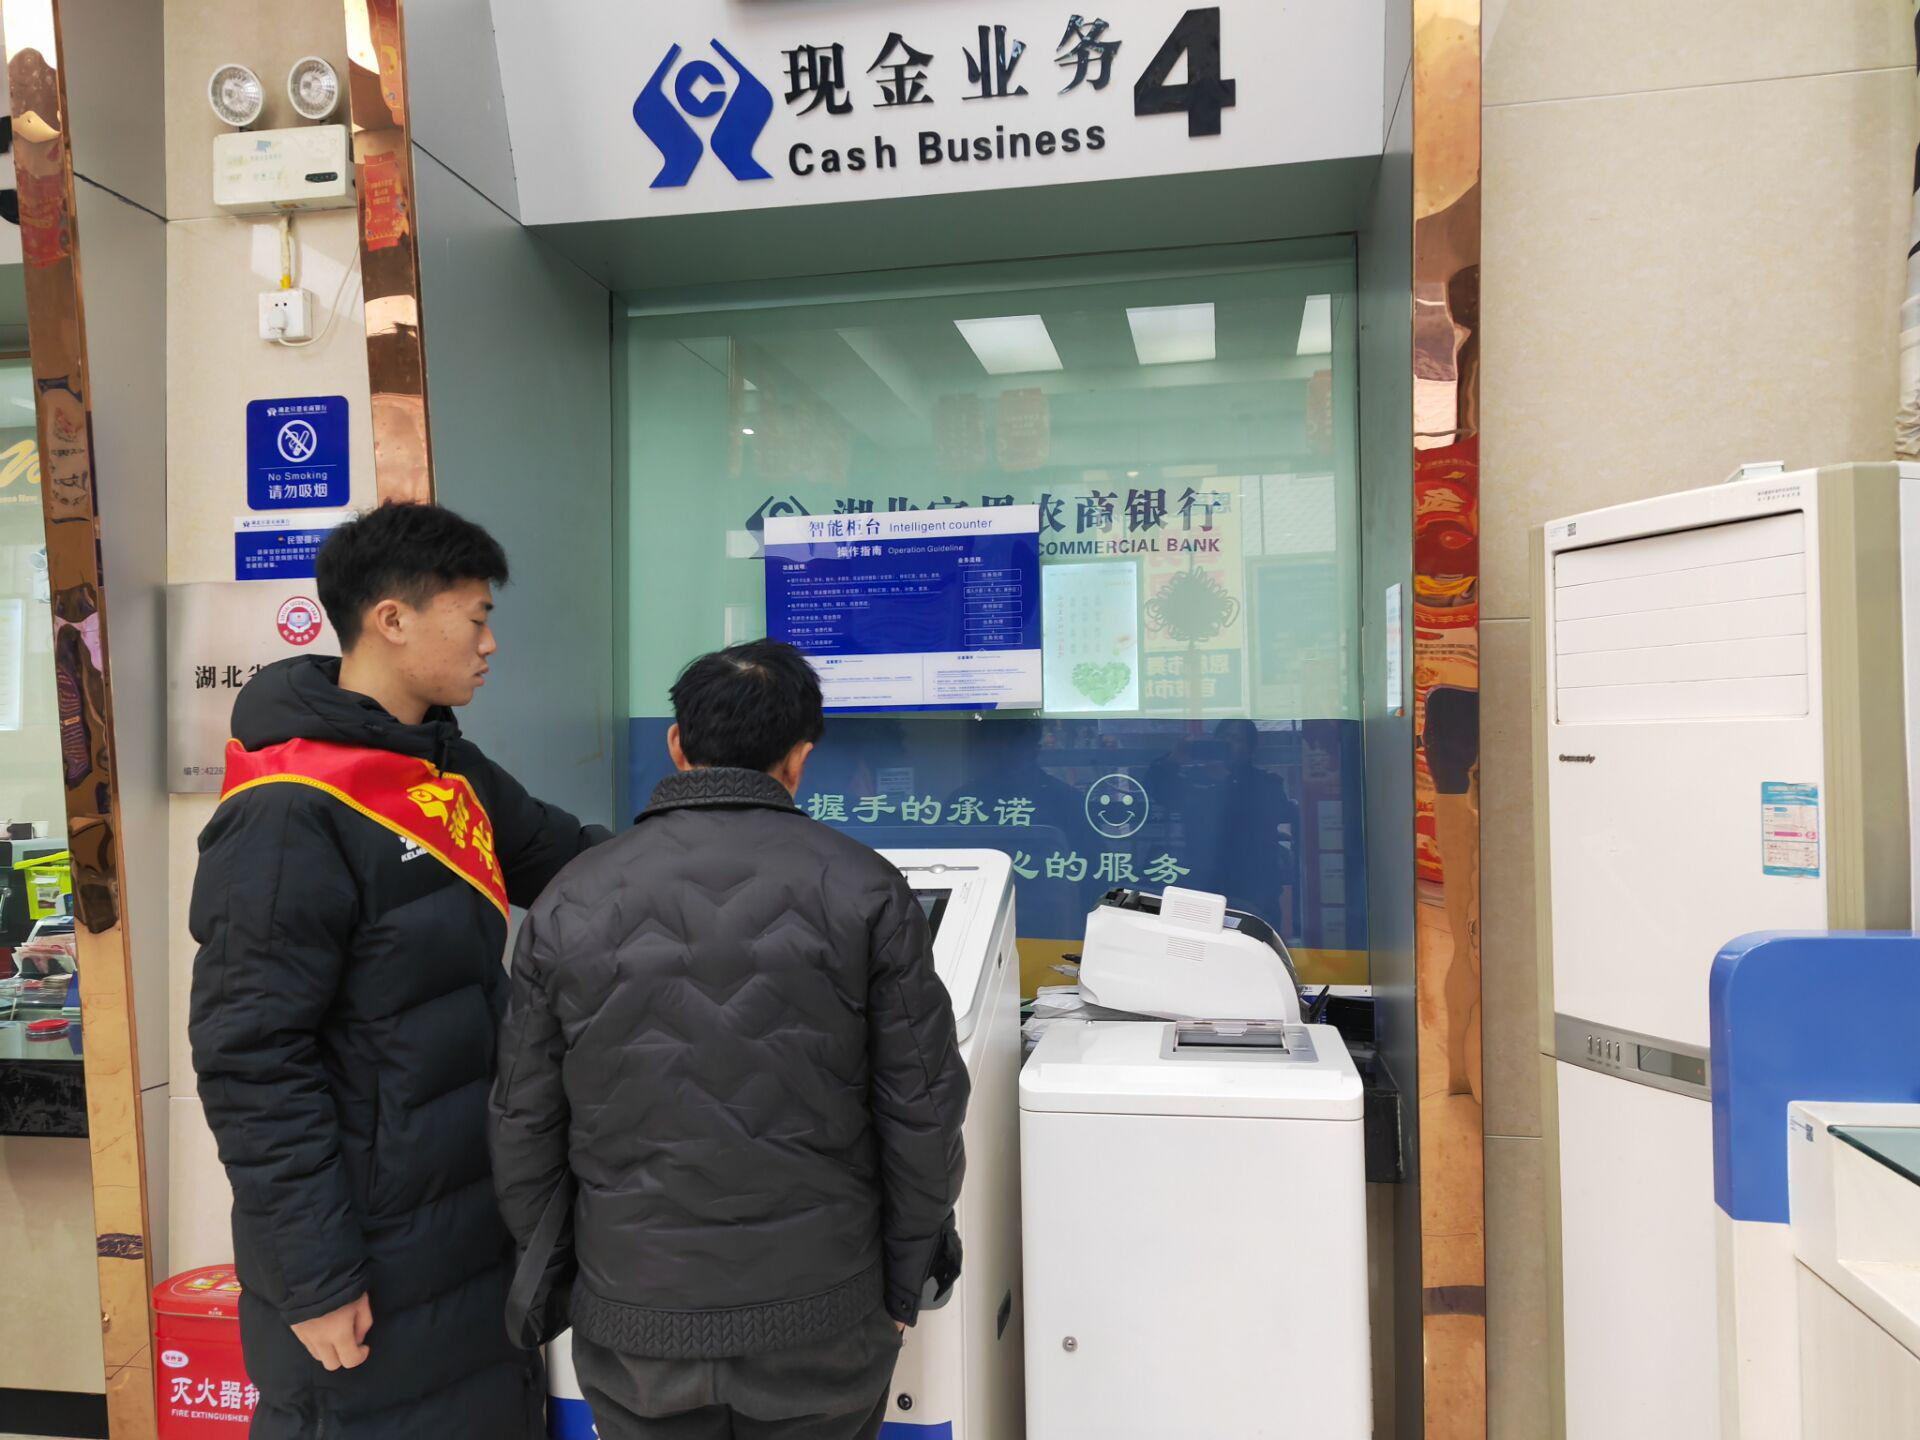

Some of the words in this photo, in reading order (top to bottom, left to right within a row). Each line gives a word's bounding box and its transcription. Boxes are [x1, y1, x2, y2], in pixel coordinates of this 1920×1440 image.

[781, 14, 1122, 116] 现金业务
[1134, 6, 1236, 138] 4
[788, 135, 897, 176] Cash
[919, 124, 1106, 165] Business
[268, 473, 281, 481] No
[284, 472, 328, 480] Smoking
[269, 483, 328, 499] 请勿吸烟
[808, 518, 881, 538] 智能柜台
[889, 521, 947, 535] Intelligent
[949, 519, 992, 530] counter
[836, 545, 882, 558] 操作指南
[888, 546, 926, 555] Operation
[927, 544, 964, 553] Guideline
[1167, 538, 1221, 553] BANK
[794, 793, 1036, 826] 握手的承诺
[171, 1409, 189, 1418] FIRE
[191, 1411, 249, 1422] EXTINGUISHER
